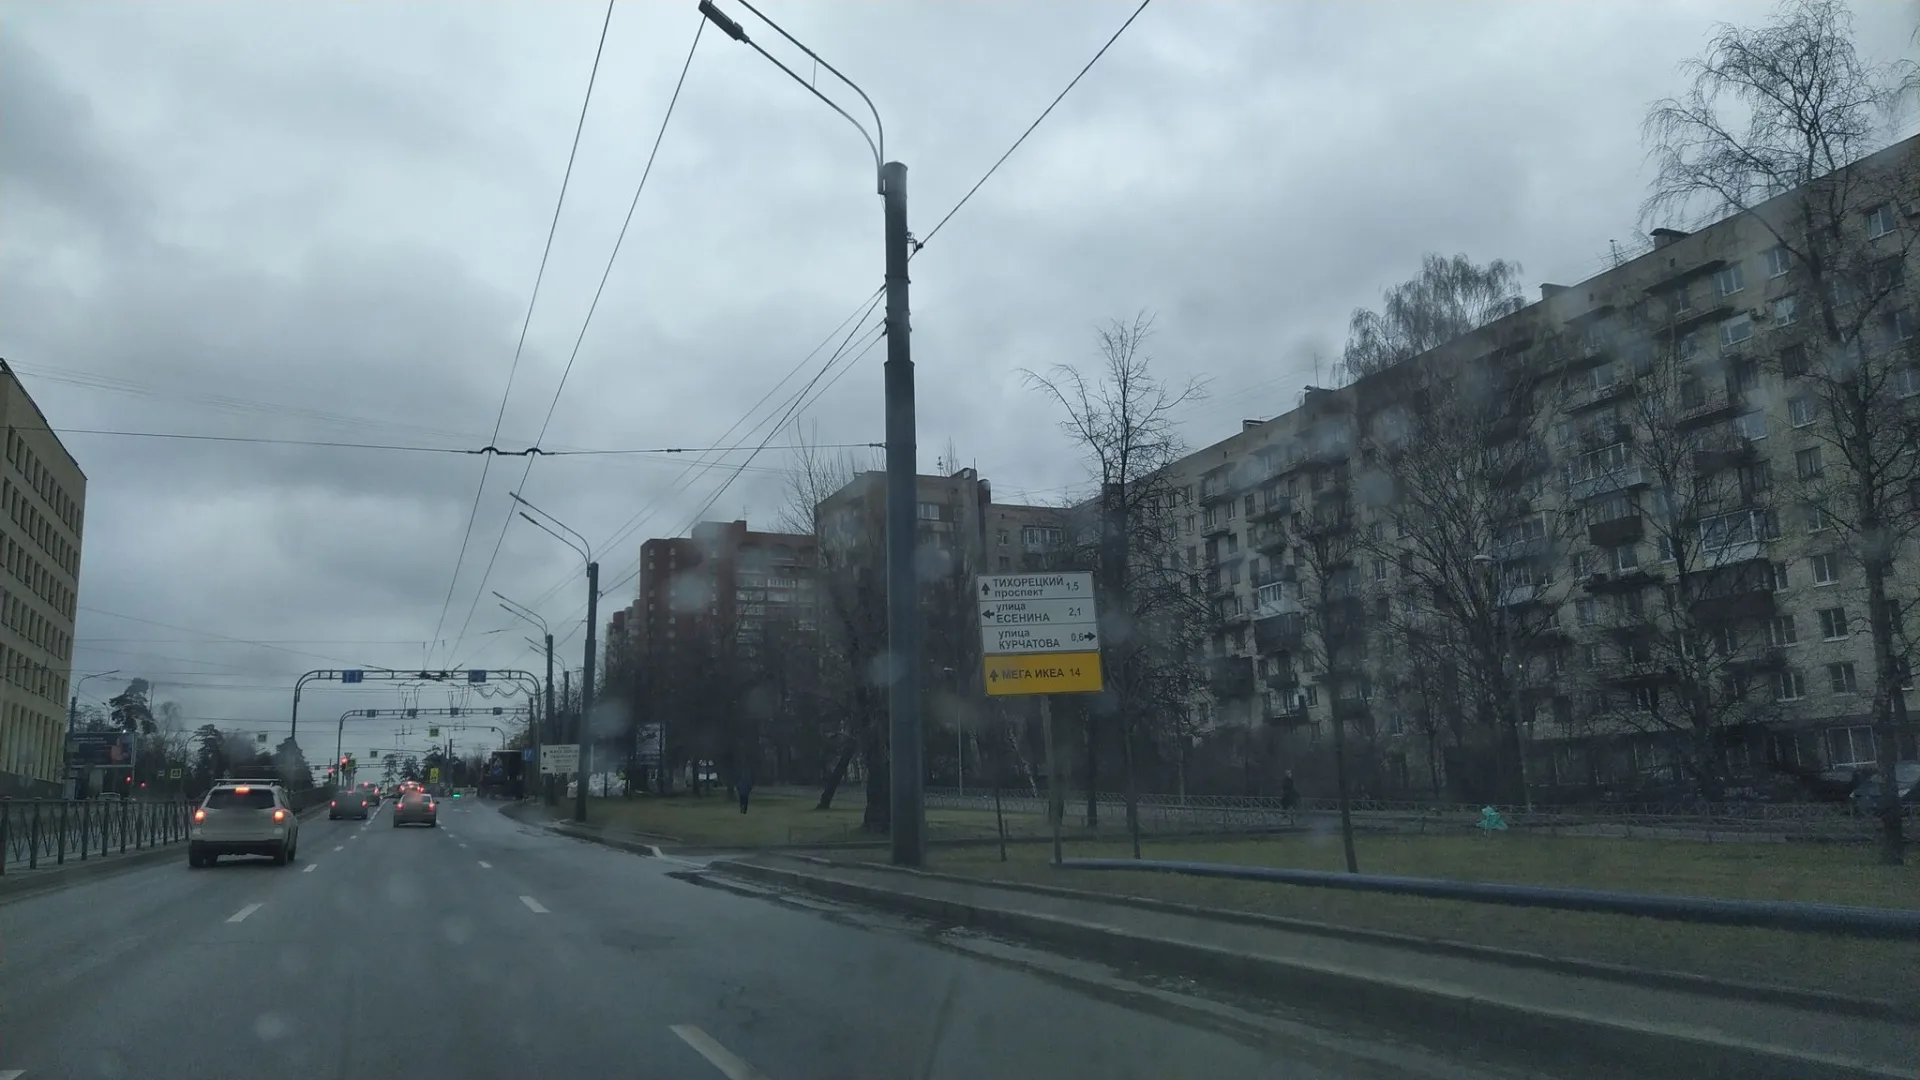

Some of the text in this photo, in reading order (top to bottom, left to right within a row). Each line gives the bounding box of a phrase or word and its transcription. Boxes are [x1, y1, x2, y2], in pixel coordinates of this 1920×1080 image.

[994, 576, 1064, 587] ТИХОРЕЦКИЙ
[1066, 582, 1079, 591] 1,5
[994, 589, 1043, 598] проспект
[996, 603, 1026, 612] улица
[1069, 608, 1081, 616] 2,1
[997, 613, 1050, 623] ЕСЕНИНА
[998, 630, 1029, 639] улица
[1071, 633, 1084, 642] 0,6
[999, 639, 1060, 650] КУРЧАТОВА
[1002, 668, 1080, 680] МЕГА ИКЕА 14
